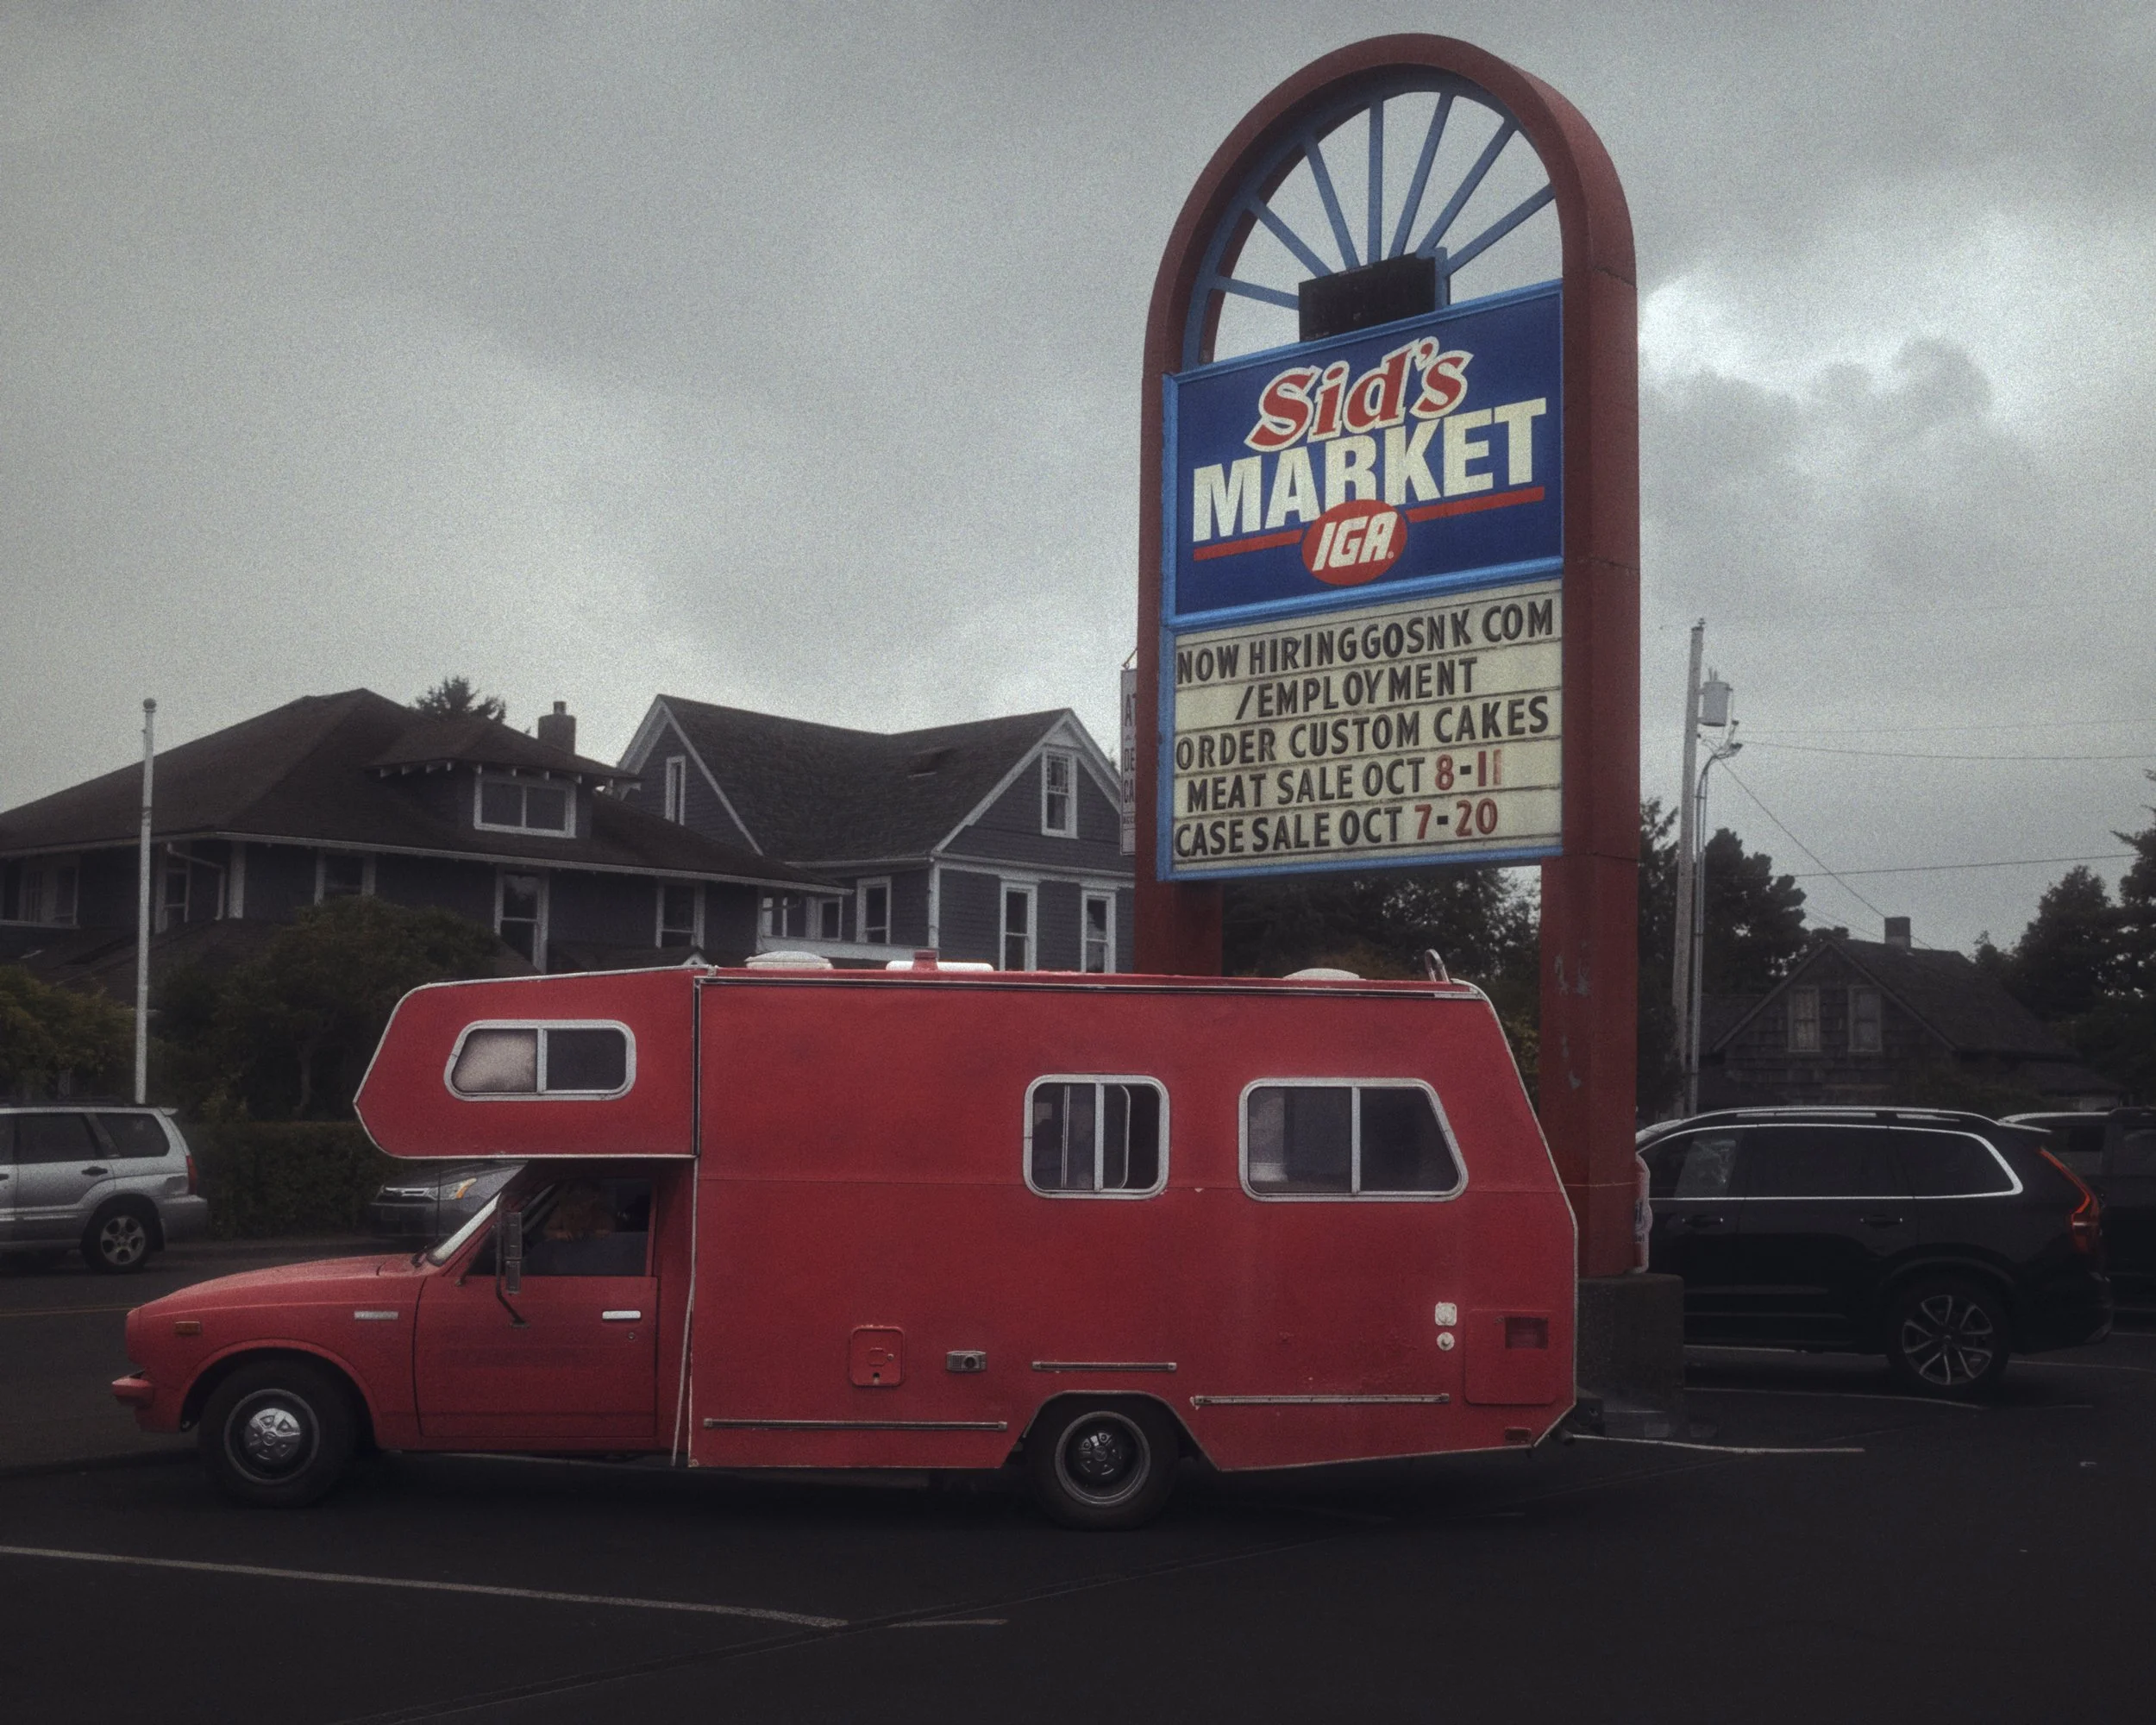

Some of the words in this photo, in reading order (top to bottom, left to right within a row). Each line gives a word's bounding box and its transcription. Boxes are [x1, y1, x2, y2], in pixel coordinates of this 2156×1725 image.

[1244, 336, 1475, 453] Sid's
[1193, 398, 1547, 543] MARKET
[1312, 511, 1397, 572] IGA
[1177, 645, 1239, 685] NOW
[1482, 599, 1553, 642] COM
[1235, 657, 1477, 720] /EMPLOYMENT
[1176, 726, 1276, 770] ORDER
[1289, 711, 1420, 759] CUSTOM
[1434, 696, 1548, 743] CAKES
[1188, 774, 1267, 812] MEAT
[1277, 764, 1353, 806] SALE
[1362, 757, 1425, 797] OCT
[1175, 822, 1244, 856] CASE
[1252, 812, 1330, 852] SALE
[1339, 806, 1402, 845] OCT
[1414, 799, 1498, 840] 7-20
